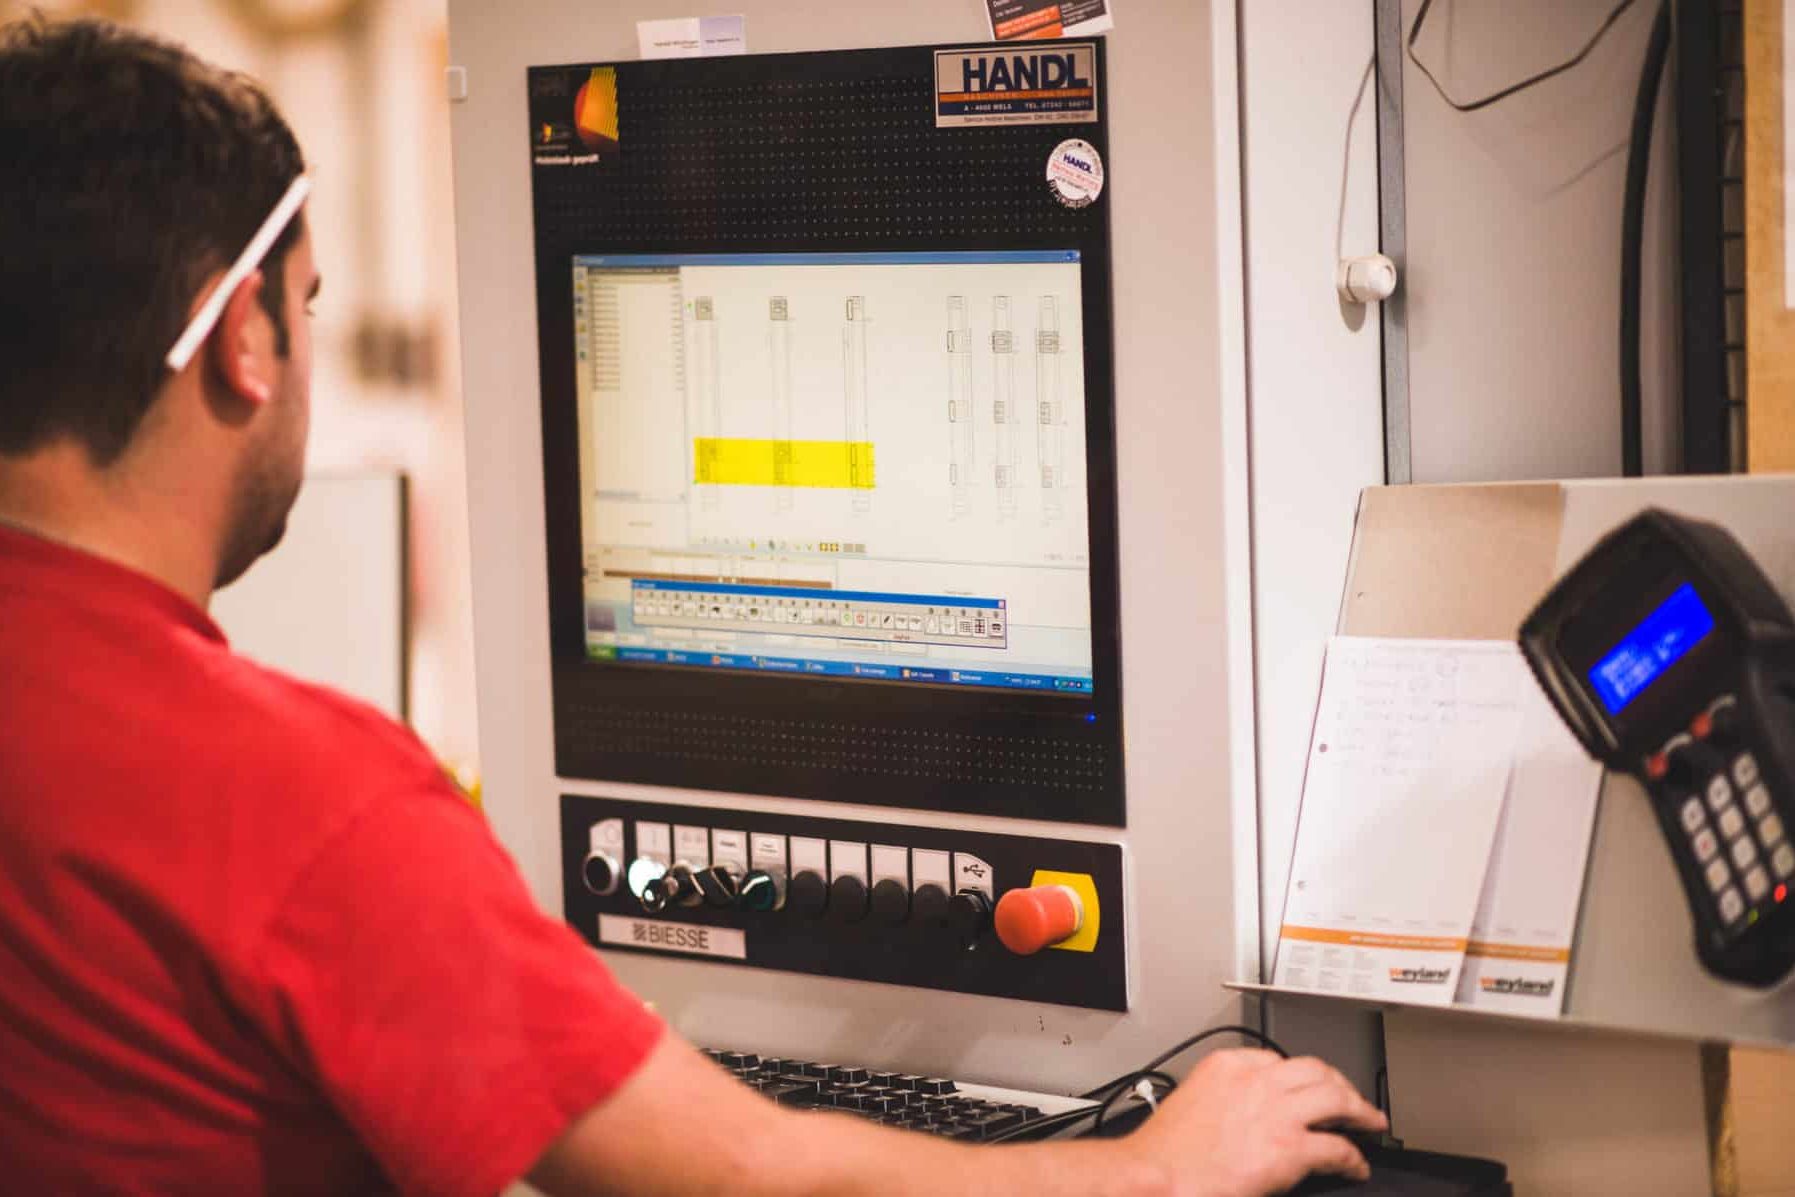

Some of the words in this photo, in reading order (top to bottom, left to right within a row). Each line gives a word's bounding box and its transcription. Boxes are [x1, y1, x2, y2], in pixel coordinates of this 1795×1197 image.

[963, 53, 1089, 93] HANDL
[1063, 153, 1093, 174] HANDL
[650, 925, 709, 949] BIESSE
